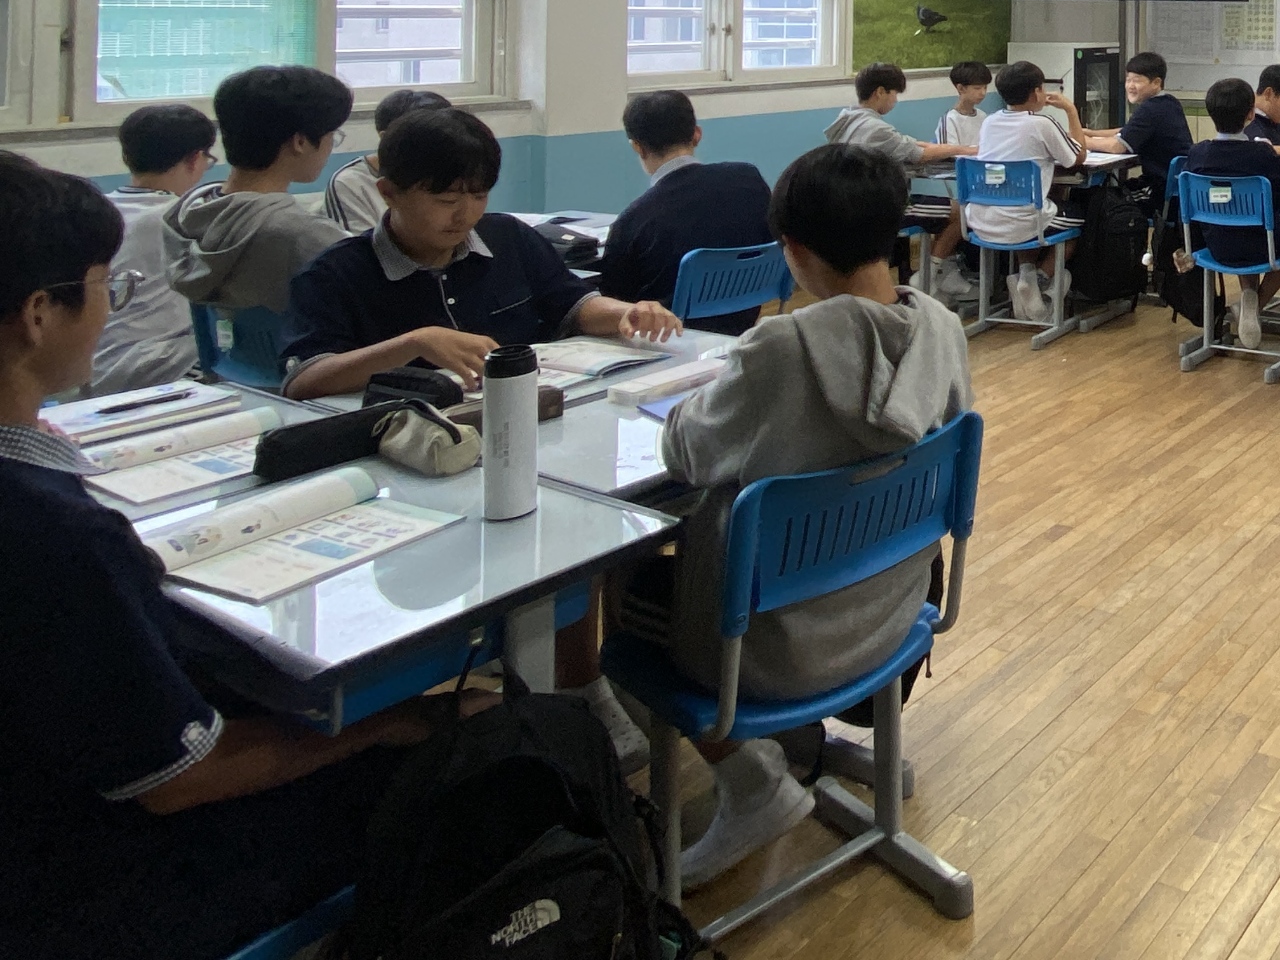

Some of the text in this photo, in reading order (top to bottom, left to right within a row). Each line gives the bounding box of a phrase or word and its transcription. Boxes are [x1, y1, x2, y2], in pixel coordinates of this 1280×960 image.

[510, 902, 536, 922] THE
[491, 912, 536, 945] NORTH
[505, 923, 538, 947] FACE
